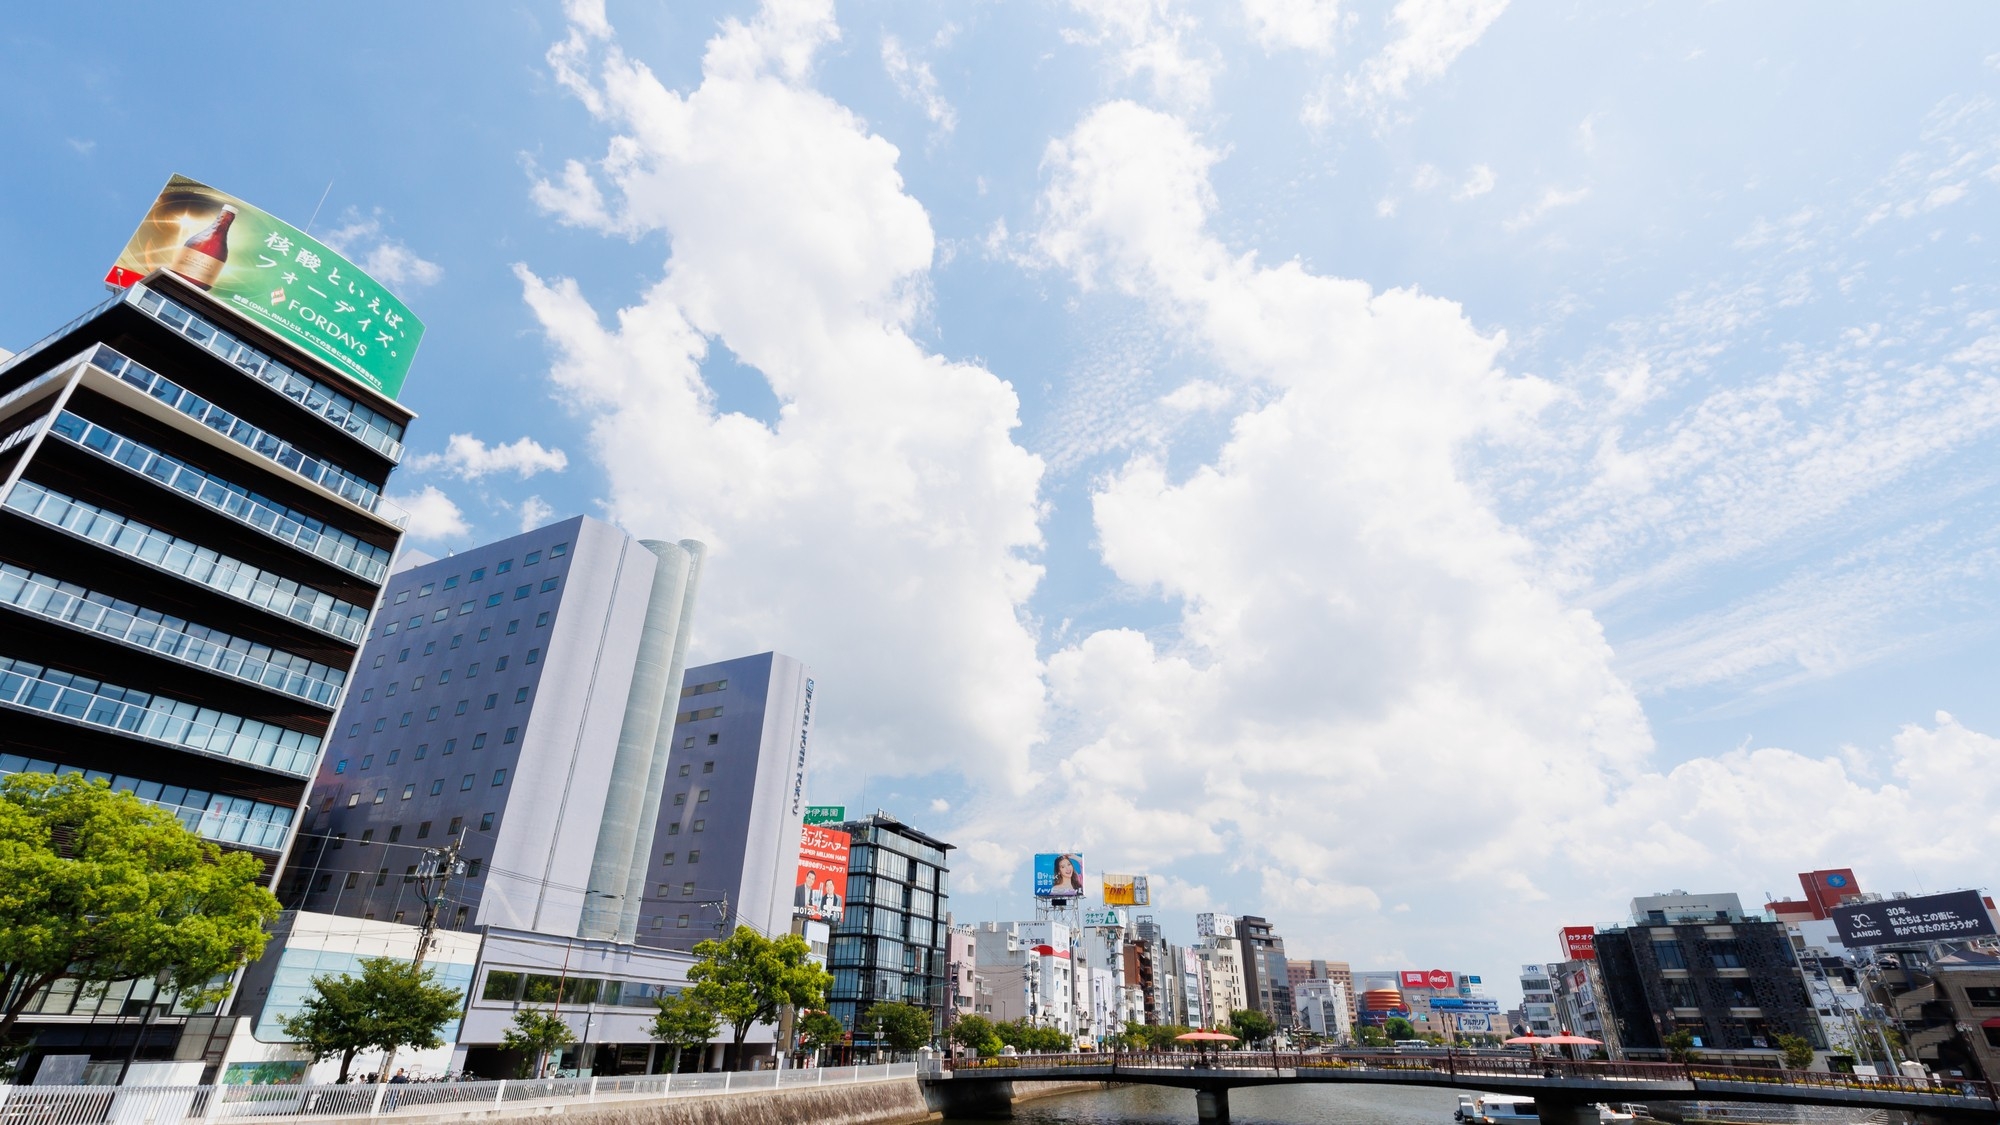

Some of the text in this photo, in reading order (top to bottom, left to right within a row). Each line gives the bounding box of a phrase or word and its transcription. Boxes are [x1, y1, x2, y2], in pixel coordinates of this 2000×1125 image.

[264, 231, 404, 338] 核酸といえば、
[288, 299, 368, 356] FORDAYS
[791, 693, 812, 816] EXCEL HOTEL TOKYU
[811, 808, 838, 817] 伊藤園
[801, 827, 829, 839] スーパー
[800, 836, 848, 851] ミリオンヘアー
[816, 850, 834, 859] MILLION
[835, 853, 847, 861] HAIR
[1889, 914, 1922, 926] 私たちは
[1850, 929, 1882, 938] LANDIC
[1893, 918, 1979, 936] 何ができたのだろうか?
